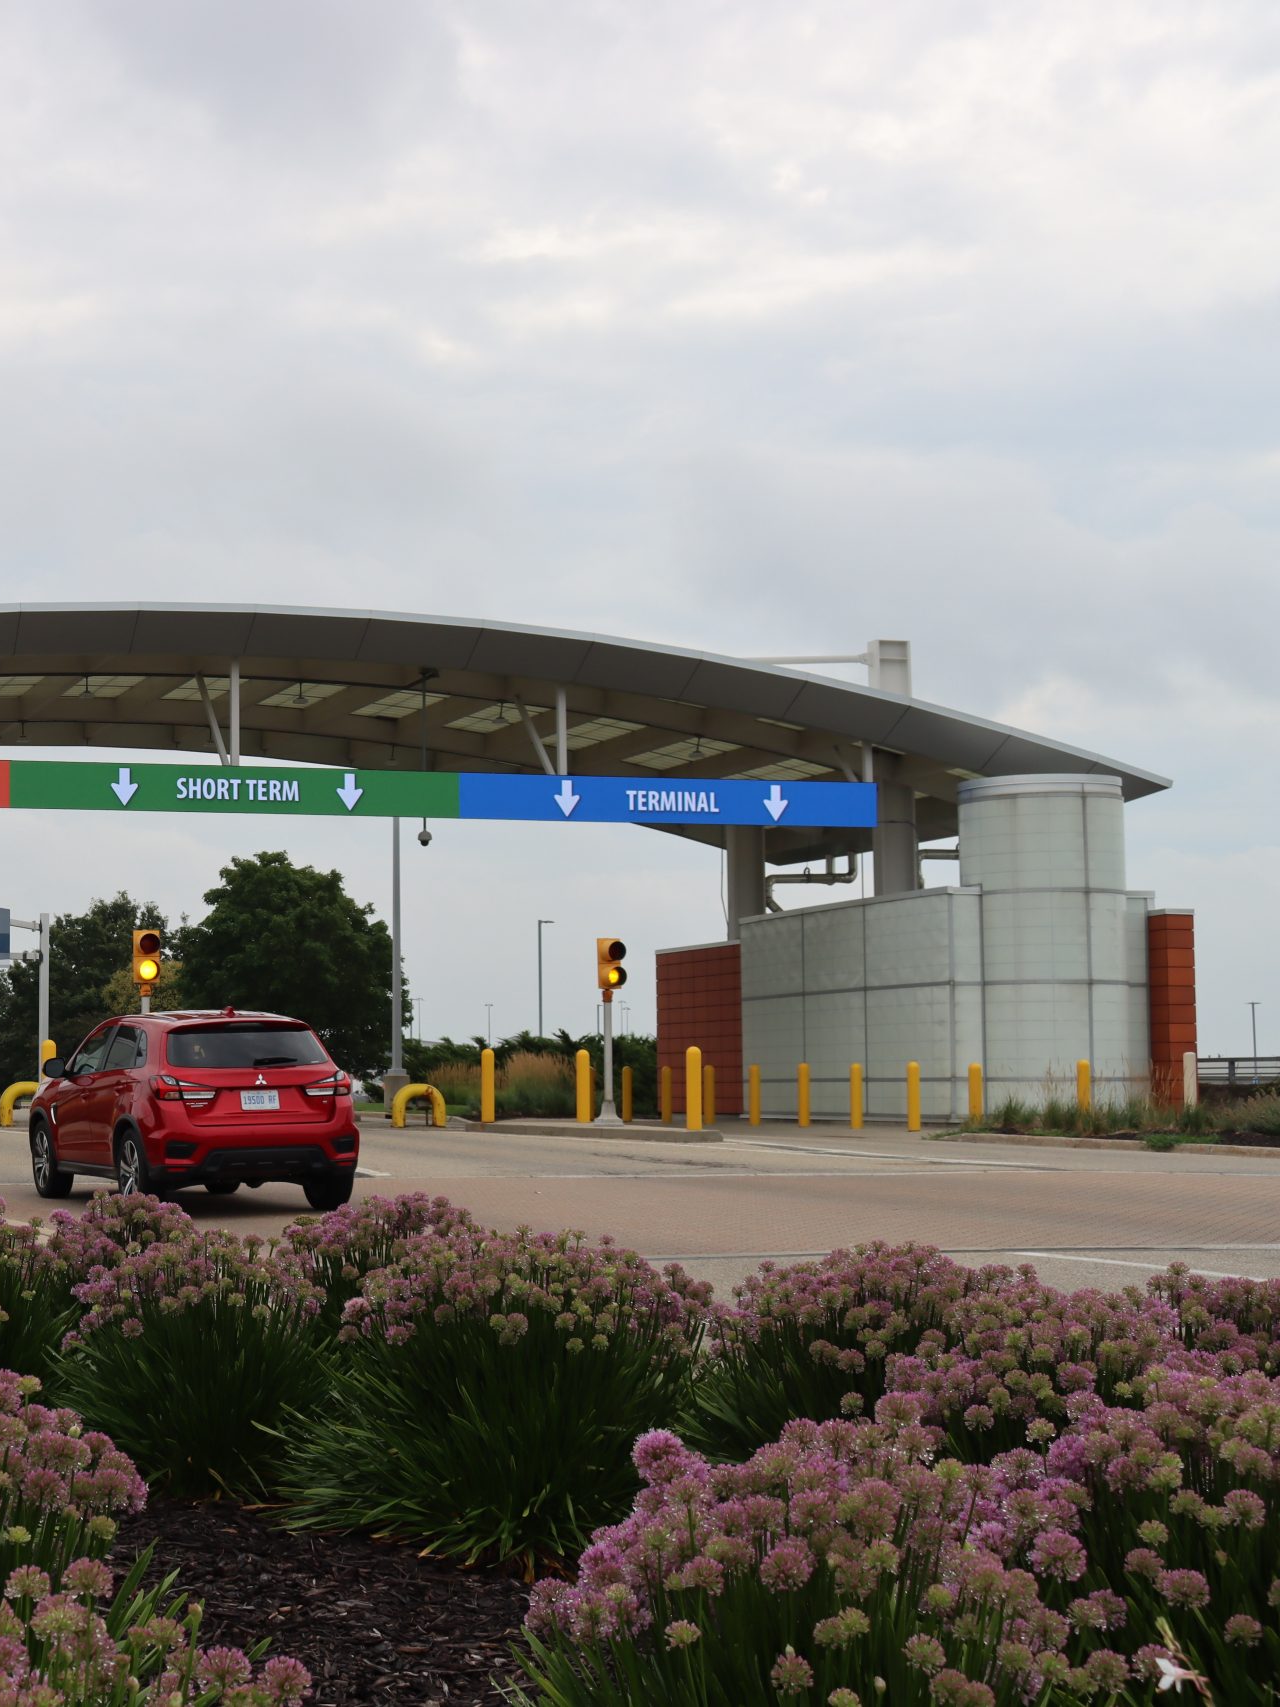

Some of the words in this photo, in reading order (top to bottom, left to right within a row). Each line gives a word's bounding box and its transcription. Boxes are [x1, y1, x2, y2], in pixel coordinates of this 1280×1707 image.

[176, 777, 241, 800] SHORT
[246, 779, 300, 802] TERM
[626, 790, 720, 813] TERMINAL
